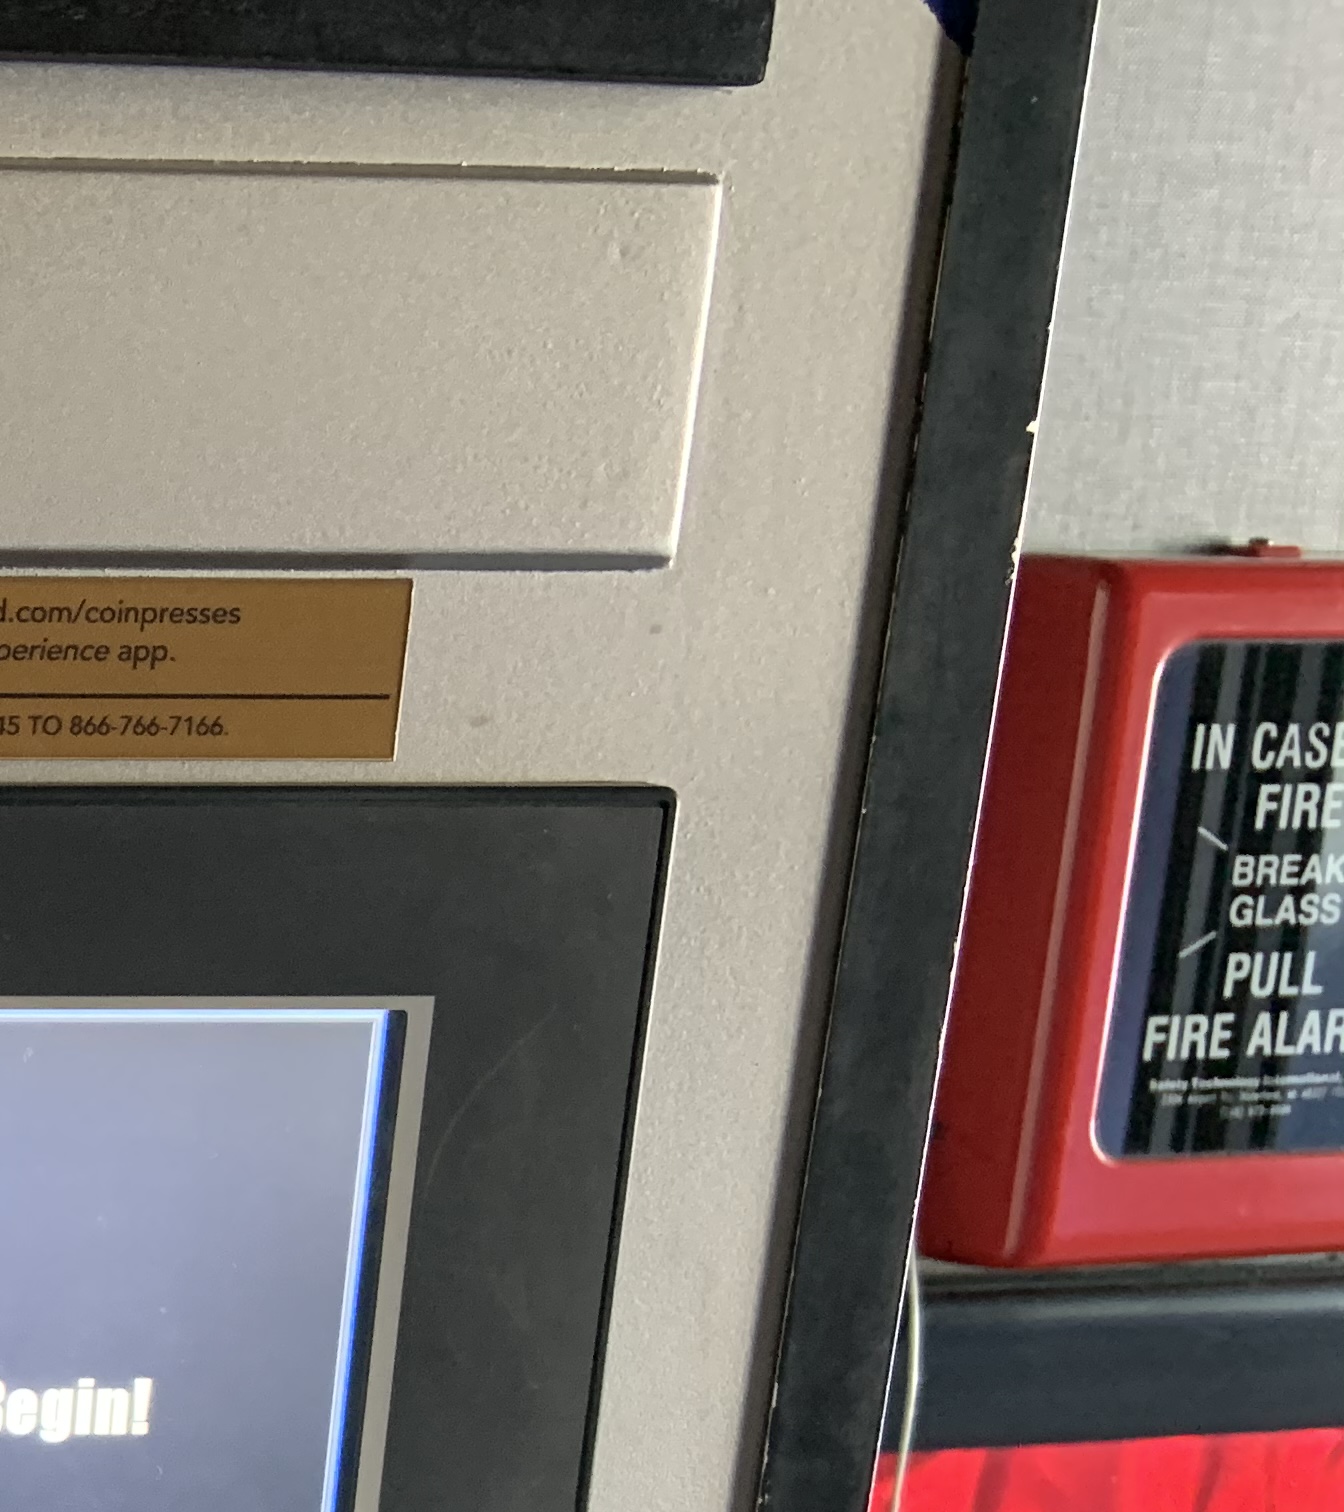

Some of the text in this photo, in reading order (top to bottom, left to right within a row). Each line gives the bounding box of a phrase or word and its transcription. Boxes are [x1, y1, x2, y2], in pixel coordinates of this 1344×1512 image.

[117, 643, 176, 670] app.
[28, 714, 63, 736] TO
[69, 715, 229, 738] 866-766-7166.
[1191, 721, 1344, 771] IN CASE
[1254, 782, 1343, 831] FIRE
[1232, 854, 1344, 886] BREAK
[1229, 893, 1341, 927] GLASS
[1222, 951, 1323, 1000] PULL
[1142, 1012, 1235, 1062] FIRE
